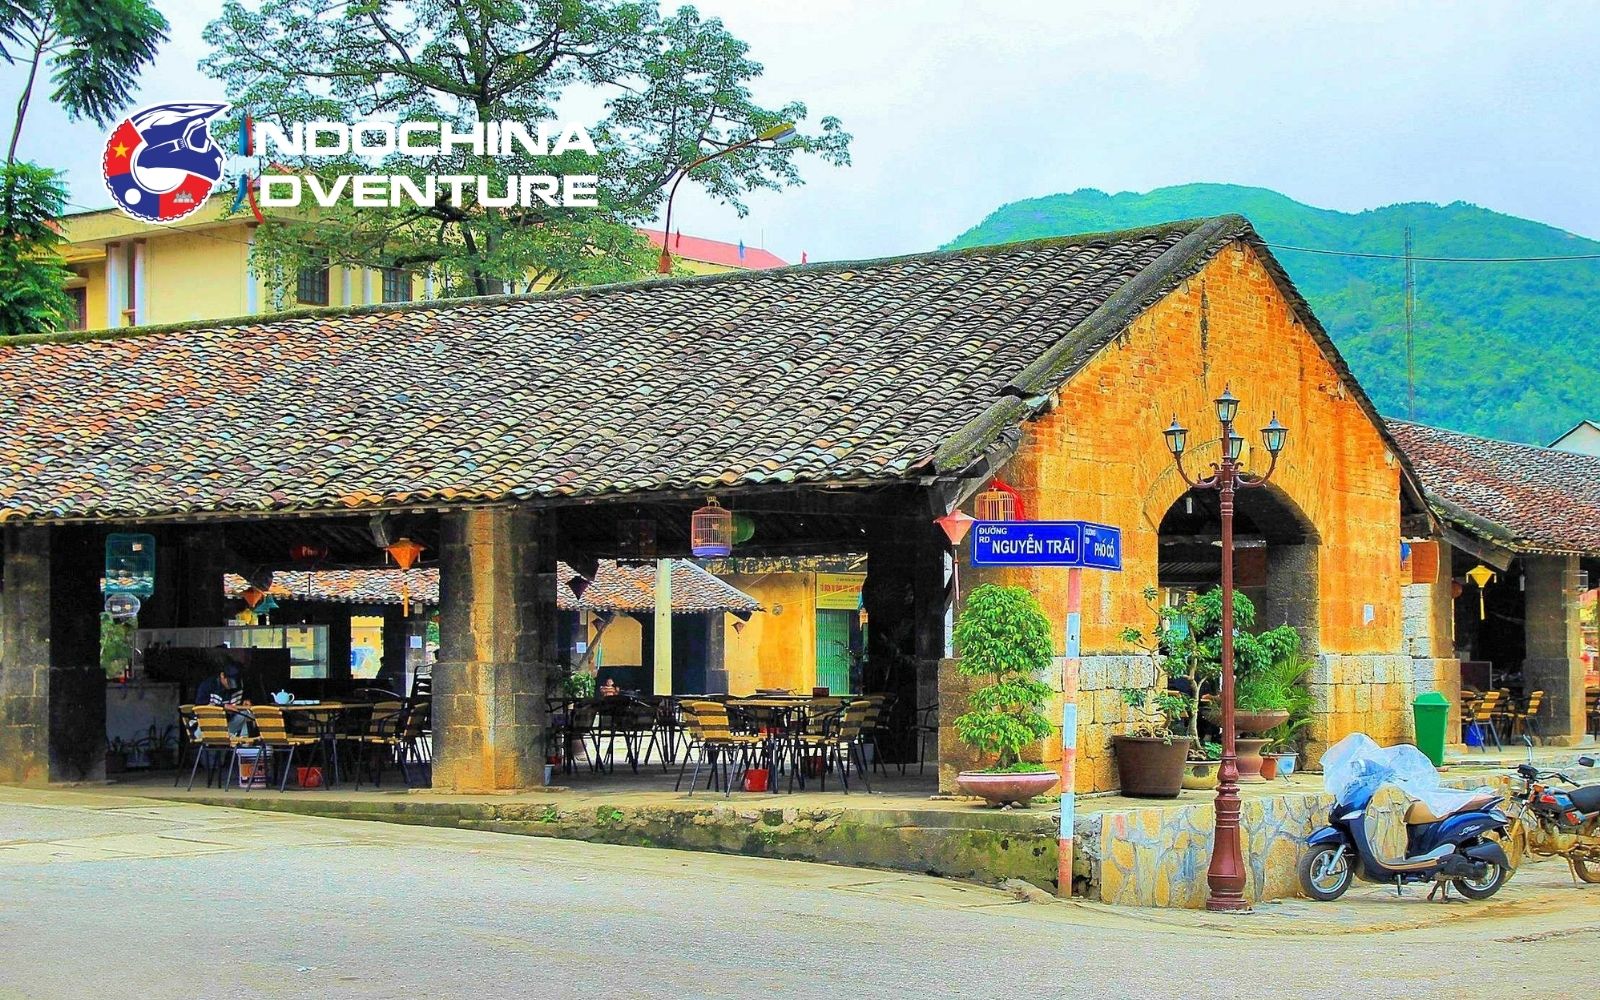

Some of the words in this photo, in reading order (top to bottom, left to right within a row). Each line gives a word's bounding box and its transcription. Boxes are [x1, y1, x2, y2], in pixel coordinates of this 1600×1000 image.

[979, 526, 1008, 535] ĐƯỜNG
[979, 536, 990, 544] RD
[992, 534, 1043, 554] NGUYỄN
[1046, 537, 1075, 554] TRÃI
